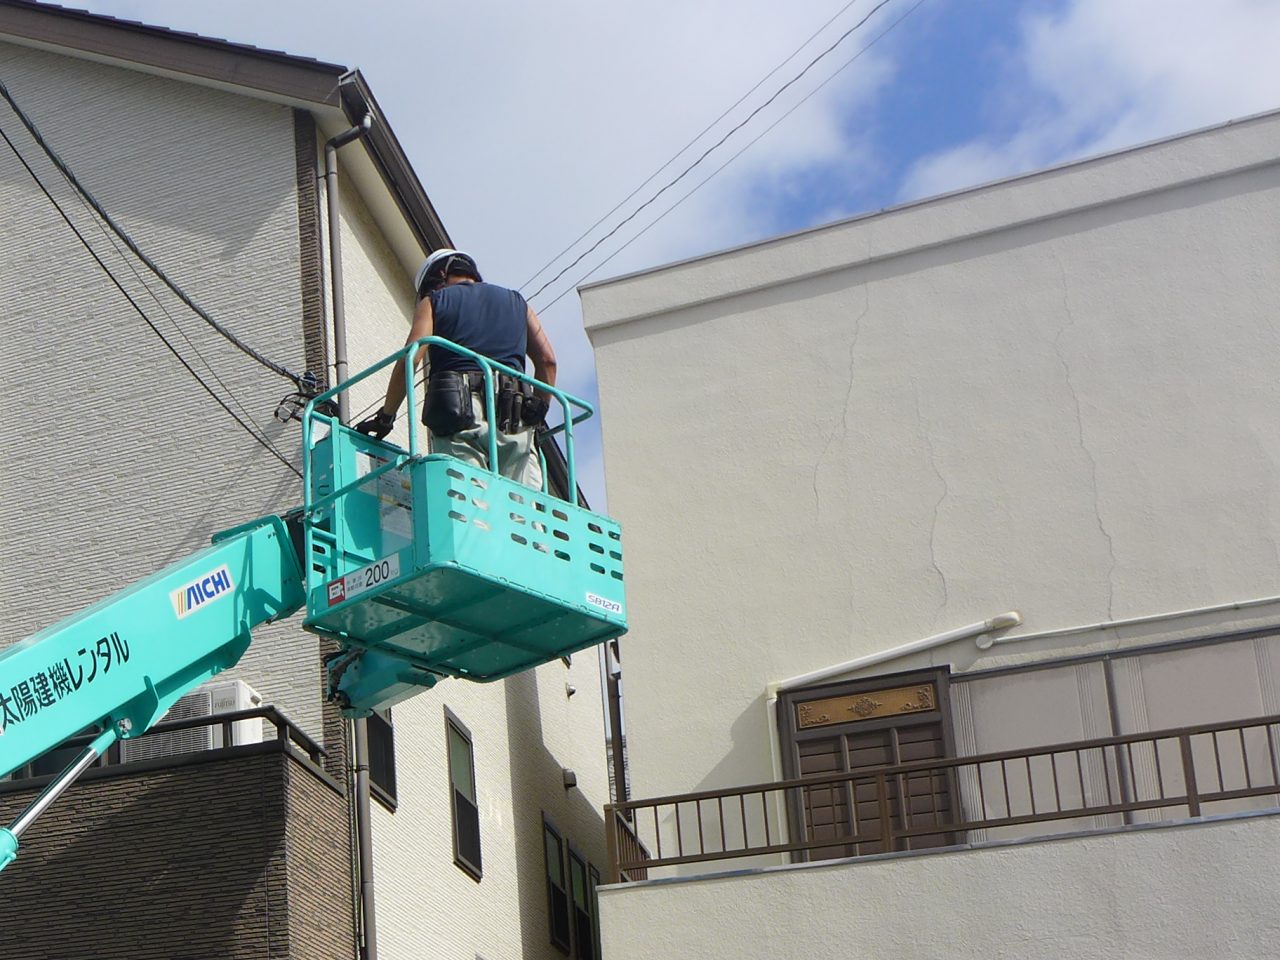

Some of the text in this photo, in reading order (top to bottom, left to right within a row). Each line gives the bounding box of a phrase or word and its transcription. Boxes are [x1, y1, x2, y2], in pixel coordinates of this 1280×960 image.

[365, 561, 389, 587] 200
[187, 569, 231, 610] AICHI
[588, 594, 620, 611] SB12A
